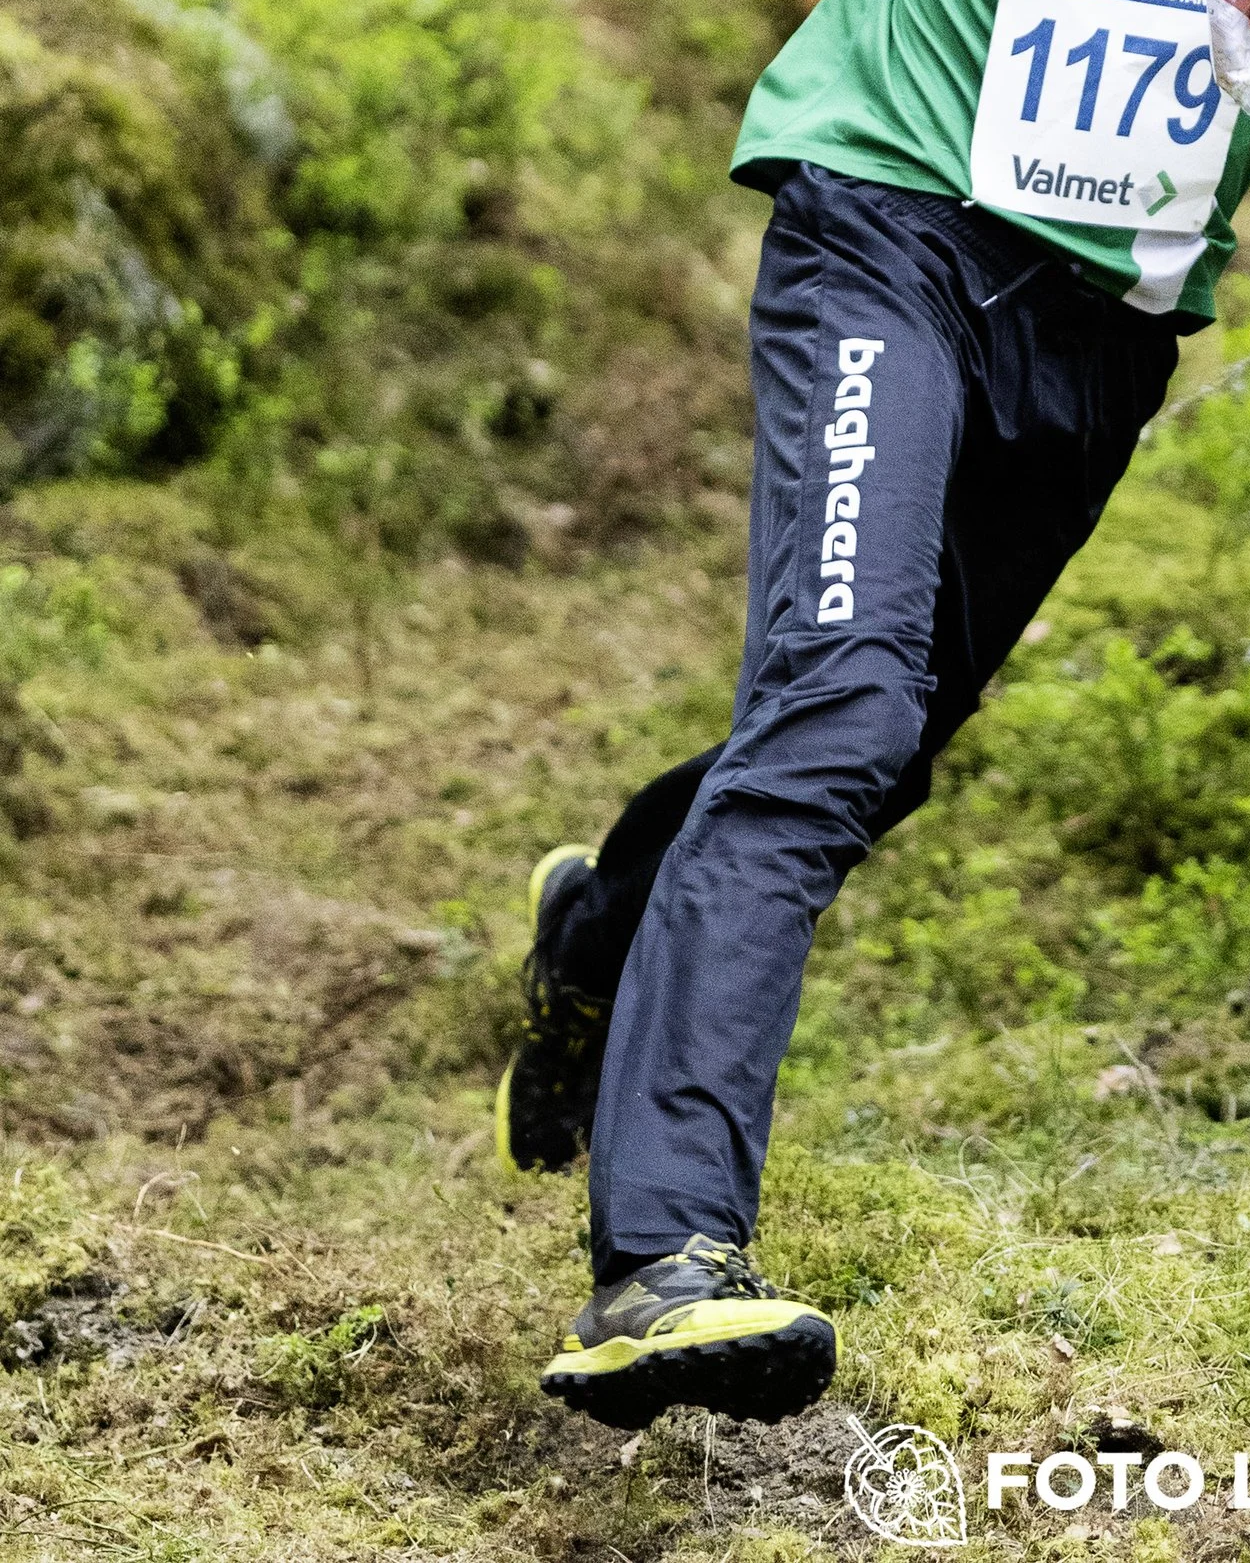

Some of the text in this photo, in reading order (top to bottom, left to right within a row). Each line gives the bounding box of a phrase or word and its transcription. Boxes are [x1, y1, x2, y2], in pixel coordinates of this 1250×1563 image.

[1011, 18, 1221, 145] 1179
[1012, 154, 1134, 206] Valmet
[817, 338, 884, 624] bagheera
